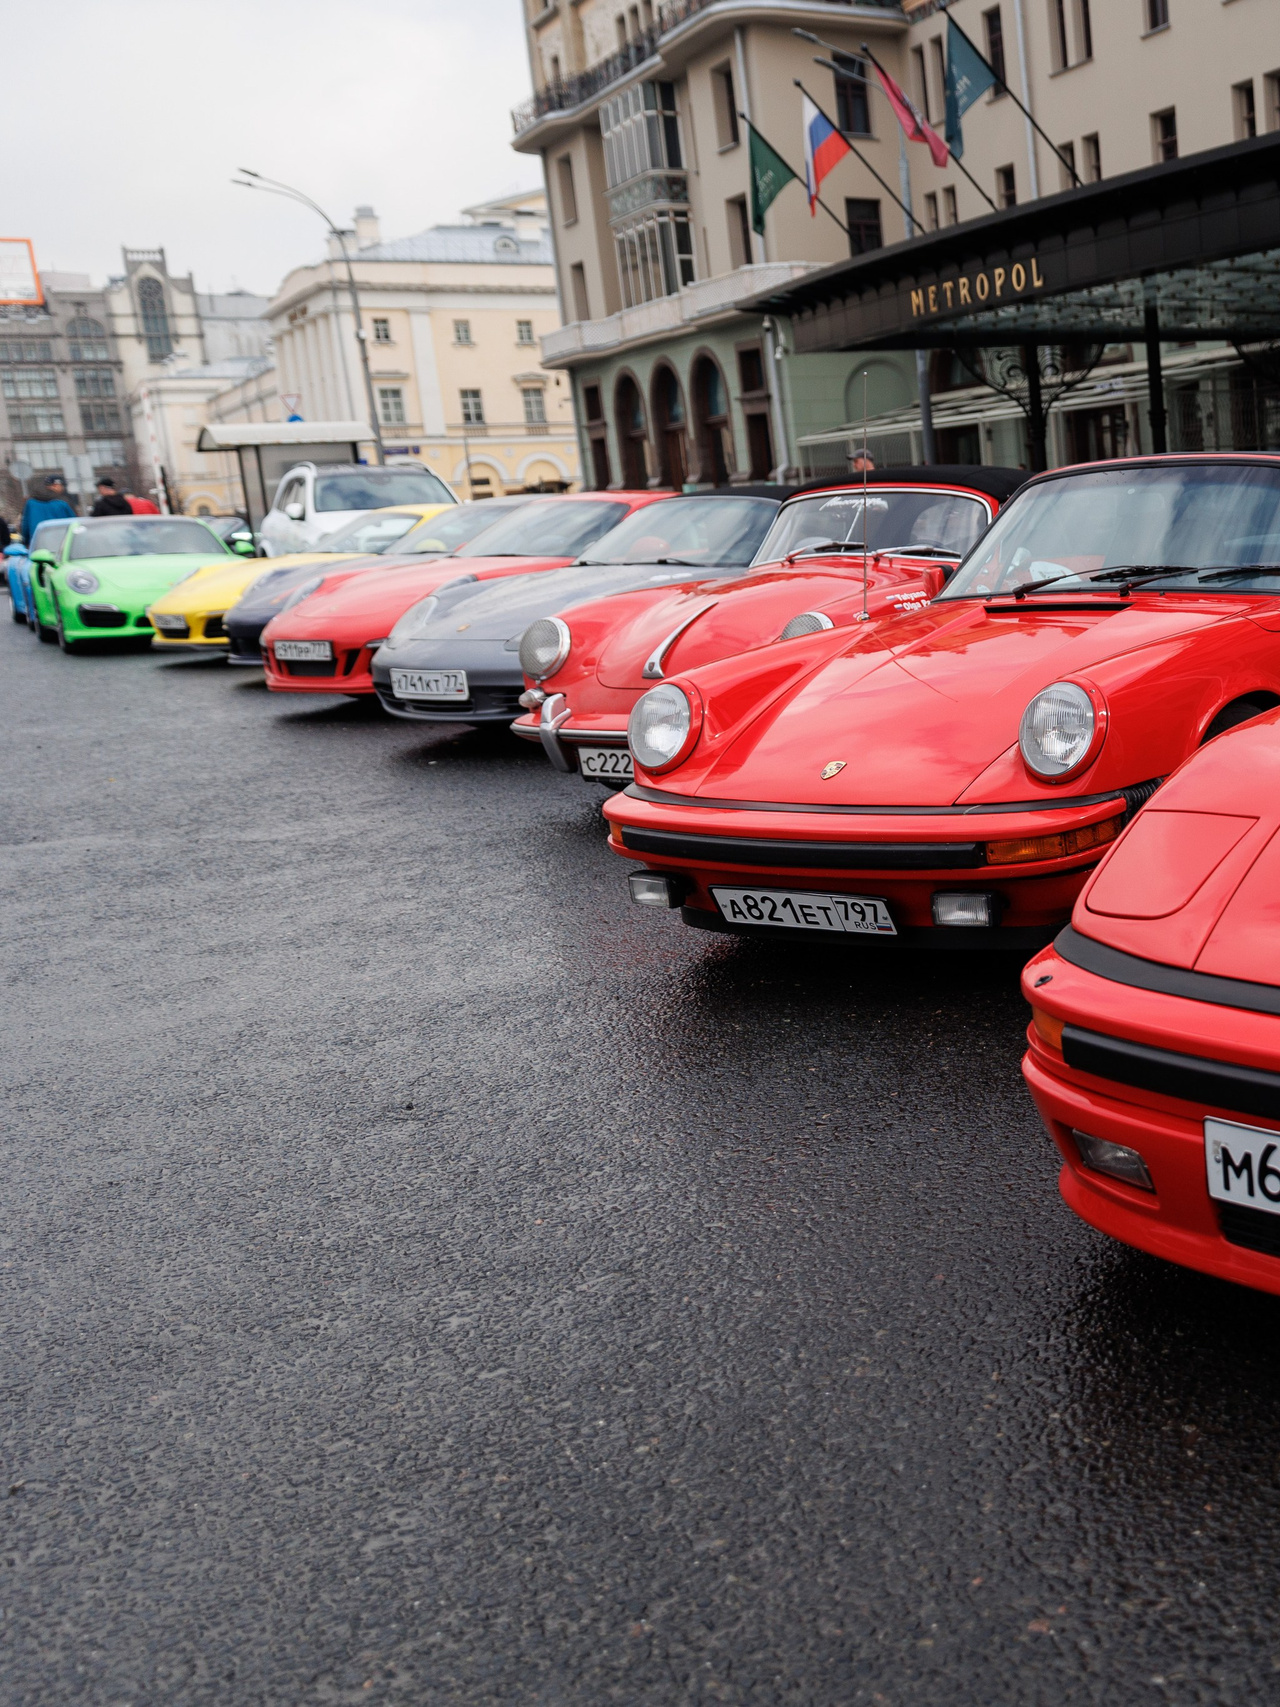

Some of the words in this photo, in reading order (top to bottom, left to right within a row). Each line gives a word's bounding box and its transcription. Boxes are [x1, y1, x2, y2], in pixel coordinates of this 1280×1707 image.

[911, 257, 1044, 317] METROPOL
[902, 601, 922, 611] Olga
[443, 674, 458, 687] 77
[729, 894, 834, 927] А821ЕТ
[835, 900, 879, 924] 797
[854, 921, 877, 931] RUS
